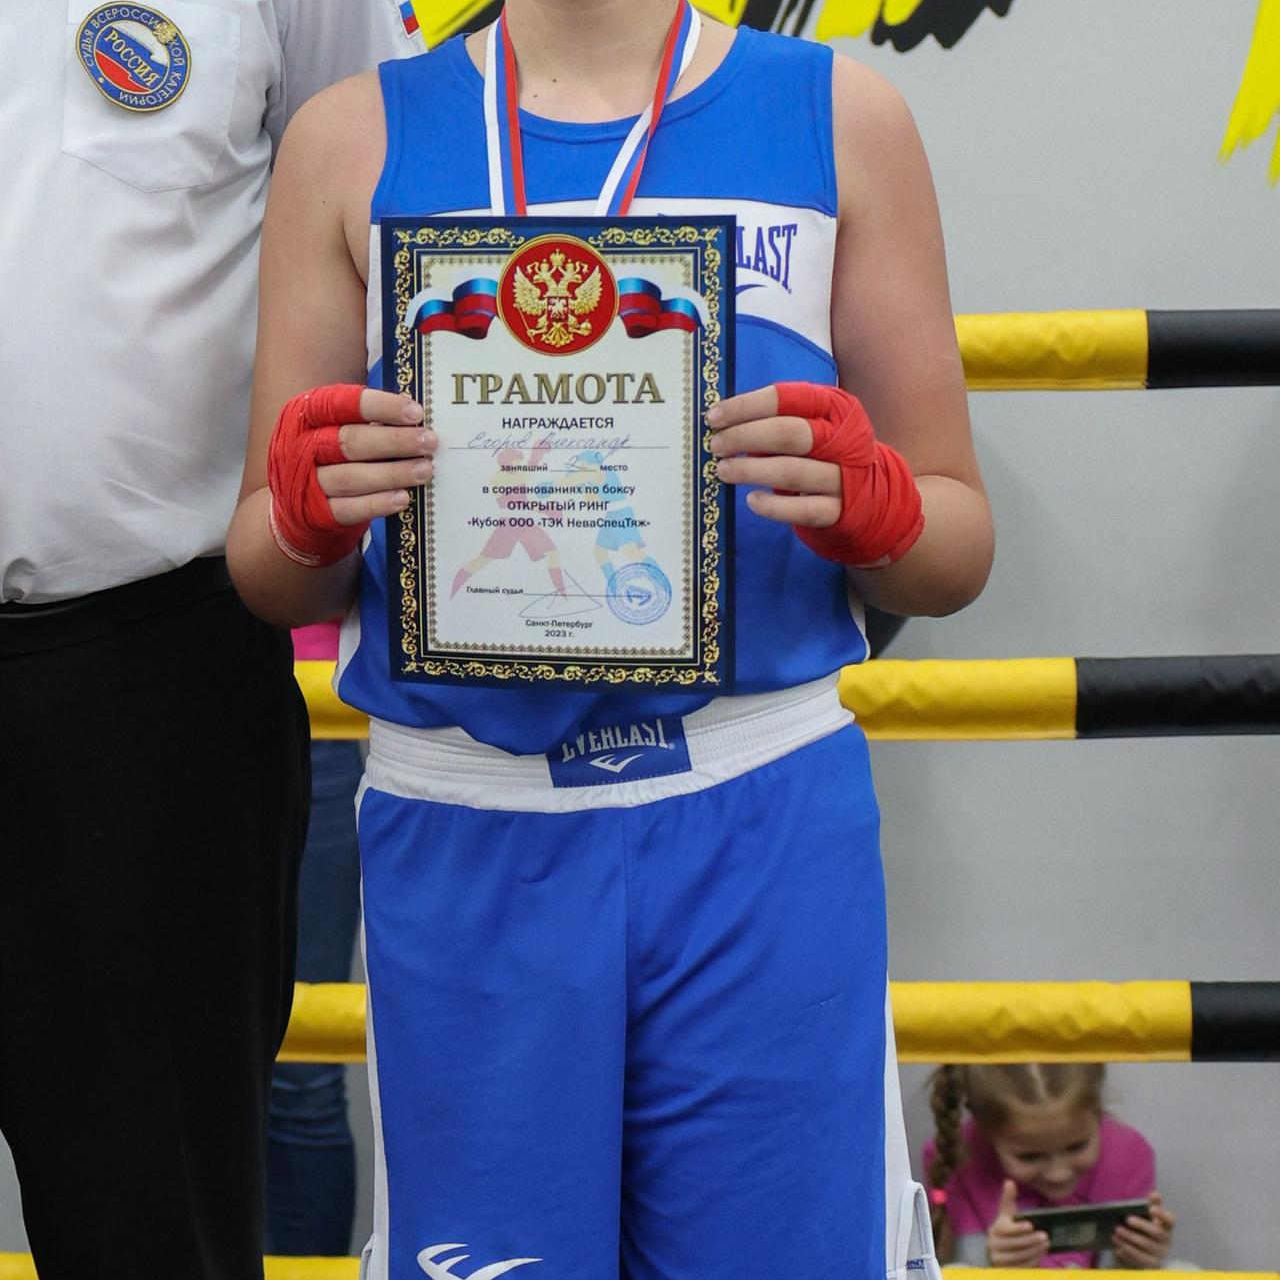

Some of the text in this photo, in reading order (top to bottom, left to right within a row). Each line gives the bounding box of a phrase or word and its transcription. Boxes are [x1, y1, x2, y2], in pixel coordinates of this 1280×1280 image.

[104, 29, 160, 87] РОССИЯ
[81, 29, 95, 67] СУДЬЯ
[119, 71, 182, 106] КАТЕГОРИИ
[736, 224, 797, 291] LAST
[451, 372, 665, 405] ГРАМОТА
[502, 417, 614, 430] НАГРАЖДАЕТСЯ
[500, 455, 628, 472] занявший 2 место
[482, 483, 635, 498] в соревнованиях по боксу
[507, 499, 610, 511] ОТКРЫТЫЙ РИНГ
[508, 518, 534, 528] ООО
[466, 585, 524, 596] Главный судья
[525, 619, 593, 629] Санкт-Петербург
[544, 630, 567, 638] 2023
